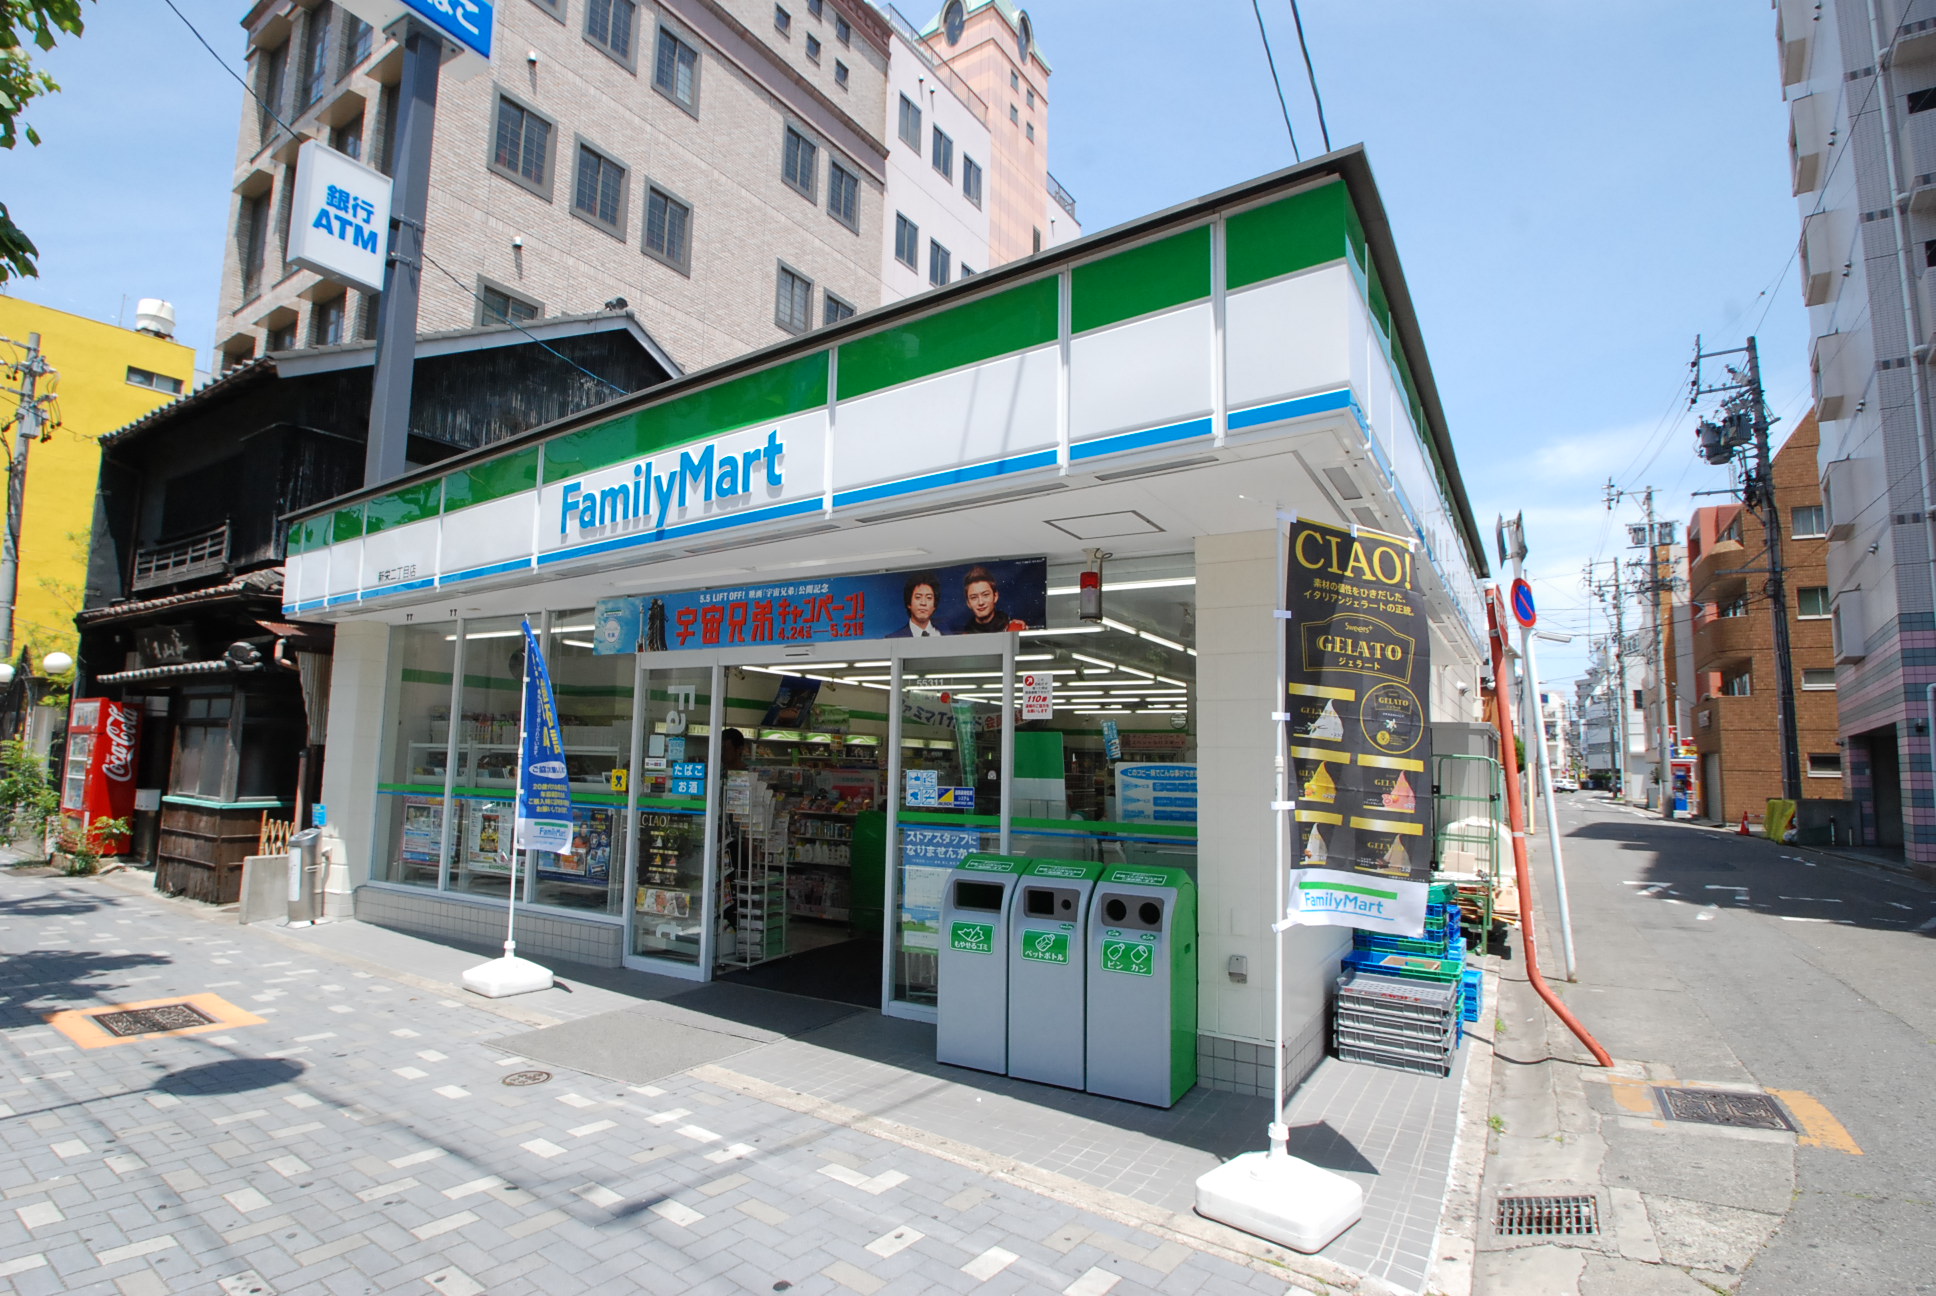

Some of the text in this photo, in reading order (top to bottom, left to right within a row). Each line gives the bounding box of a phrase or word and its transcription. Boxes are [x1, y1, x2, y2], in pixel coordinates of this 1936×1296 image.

[326, 184, 375, 225] 銀行
[312, 208, 379, 255] ATM
[560, 428, 784, 535] FamilyMart
[1295, 529, 1412, 590] CIAO!
[712, 591, 728, 602] LIFT
[728, 589, 746, 602] OFF!
[1303, 589, 1415, 616] イタリアンジェラートの正統。
[1313, 578, 1407, 603] 素材の個性をひきだした、
[676, 599, 774, 647] 宇宙兄弟
[1316, 635, 1402, 661] GELATO
[1338, 656, 1381, 671] ジェラート
[1378, 696, 1409, 707] GELATO
[102, 703, 139, 782] Coca-Cola
[674, 763, 703, 776] たばこ
[678, 781, 698, 793] お酒
[906, 831, 977, 845] ストアスタッフに
[1304, 891, 1384, 915] FamilyMart
[954, 940, 988, 951] もやせるゴミ
[1025, 949, 1065, 962] ペットボトル
[1130, 962, 1147, 973] カン
